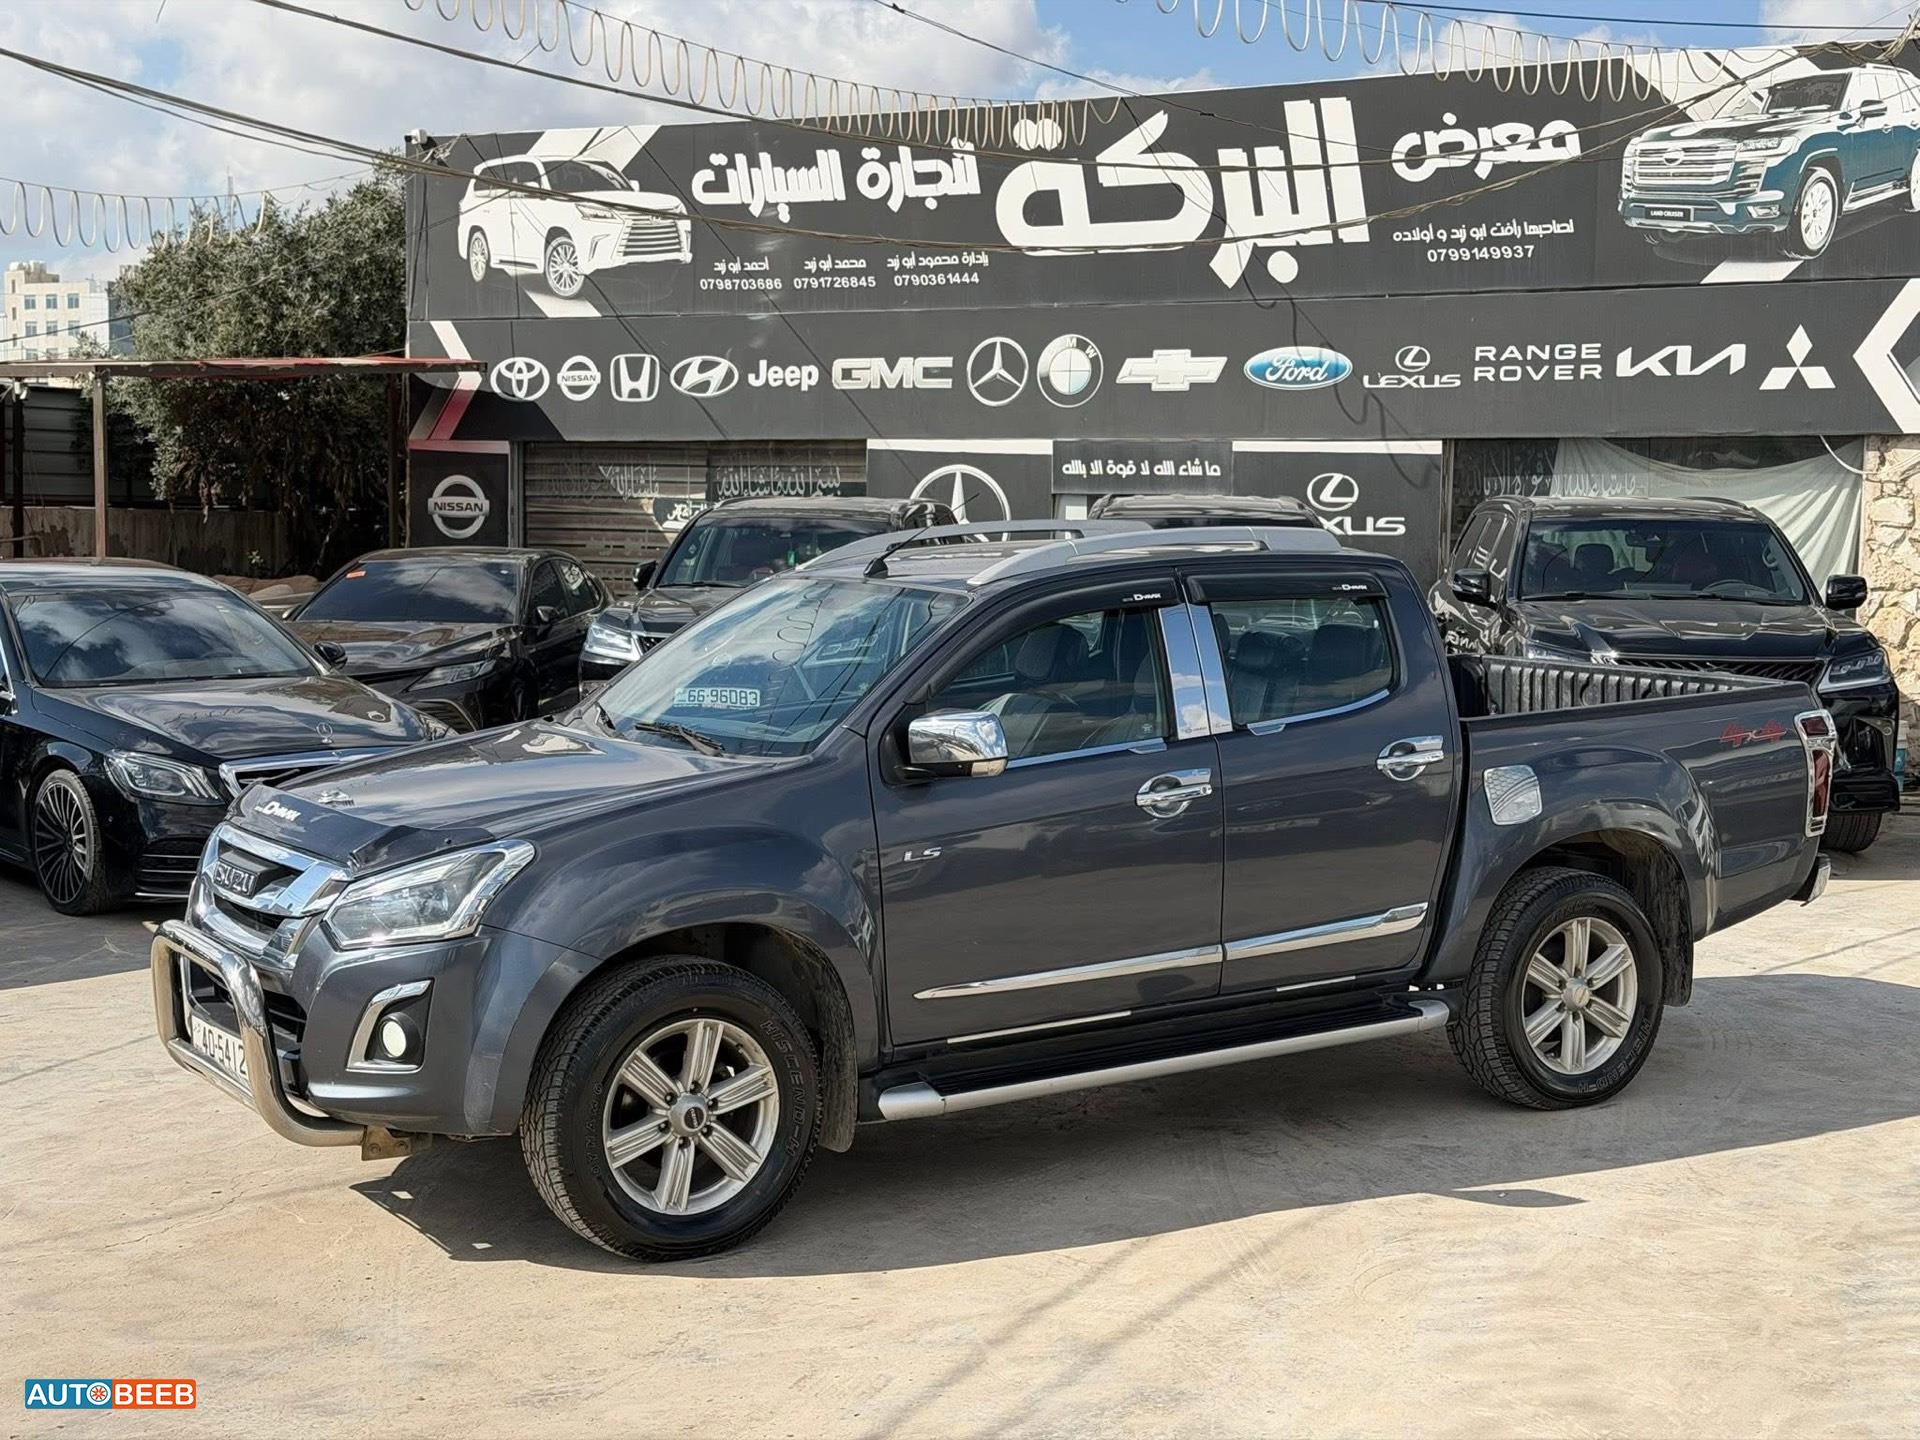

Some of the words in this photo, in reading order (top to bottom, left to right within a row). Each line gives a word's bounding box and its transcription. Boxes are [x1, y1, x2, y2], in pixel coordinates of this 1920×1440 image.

[1391, 112, 1581, 182] معرض
[856, 136, 982, 213] لتجارة
[691, 148, 847, 223] السيارات
[996, 97, 1370, 289] البركة
[1436, 229, 1447, 242] و
[1450, 224, 1467, 244] زيد
[1523, 218, 1575, 238] لصاحبها
[918, 254, 959, 269] محمود
[1427, 245, 1535, 262] 0799149937
[713, 258, 727, 276] زيد
[803, 257, 817, 274] زيد
[834, 258, 867, 269] محمد
[886, 254, 900, 271] زيد
[699, 278, 782, 290] 0798703686
[793, 275, 876, 289] 0791726845
[893, 272, 980, 287] 0790361444
[1474, 343, 1602, 361] RANGE
[748, 359, 819, 391] Jeep
[832, 356, 954, 389] GMC
[1264, 355, 1330, 382] Ford
[1473, 364, 1602, 382] ROVER
[561, 374, 597, 383] NISSAN
[1362, 373, 1461, 388] LEXUS
[1062, 460, 1087, 478] بالله
[1106, 460, 1137, 478] قوة
[1140, 460, 1150, 476] لا
[1153, 460, 1176, 476] الله
[1178, 458, 1203, 476] شاء
[1205, 460, 1221, 476] ما
[433, 502, 484, 512] NISSAN
[1318, 515, 1406, 536] XUS
[903, 846, 942, 862] LS
